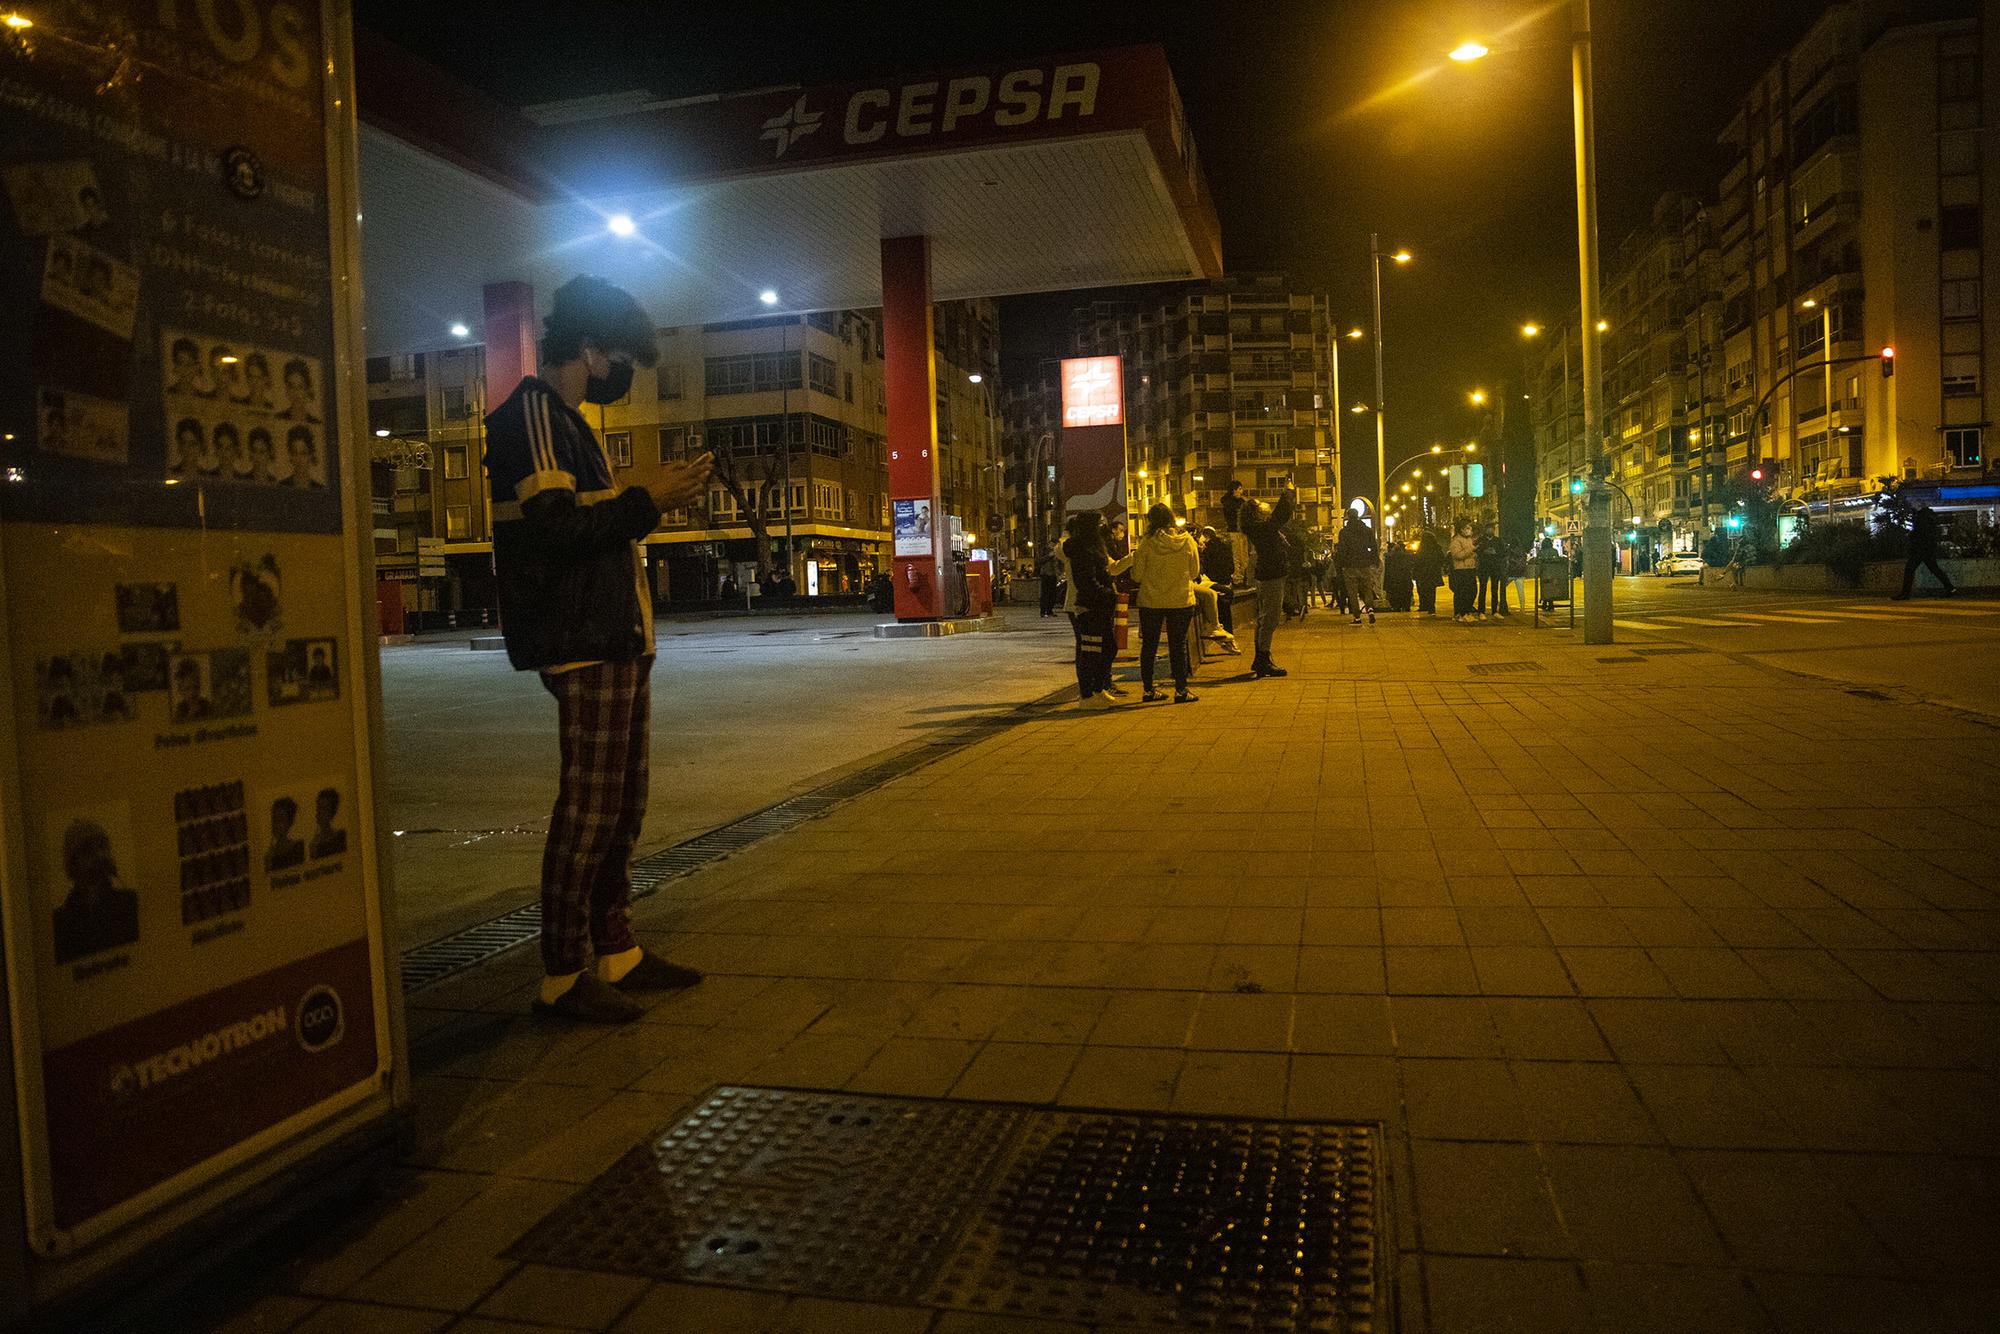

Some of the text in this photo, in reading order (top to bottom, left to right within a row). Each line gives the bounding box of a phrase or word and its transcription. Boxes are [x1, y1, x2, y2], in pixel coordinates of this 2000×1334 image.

[844, 62, 1101, 146] CEPSA
[1066, 404, 1119, 420] CEPSA
[892, 451, 898, 460] 5
[922, 449, 928, 458] 6
[135, 1005, 287, 1090] TECNOTRON
